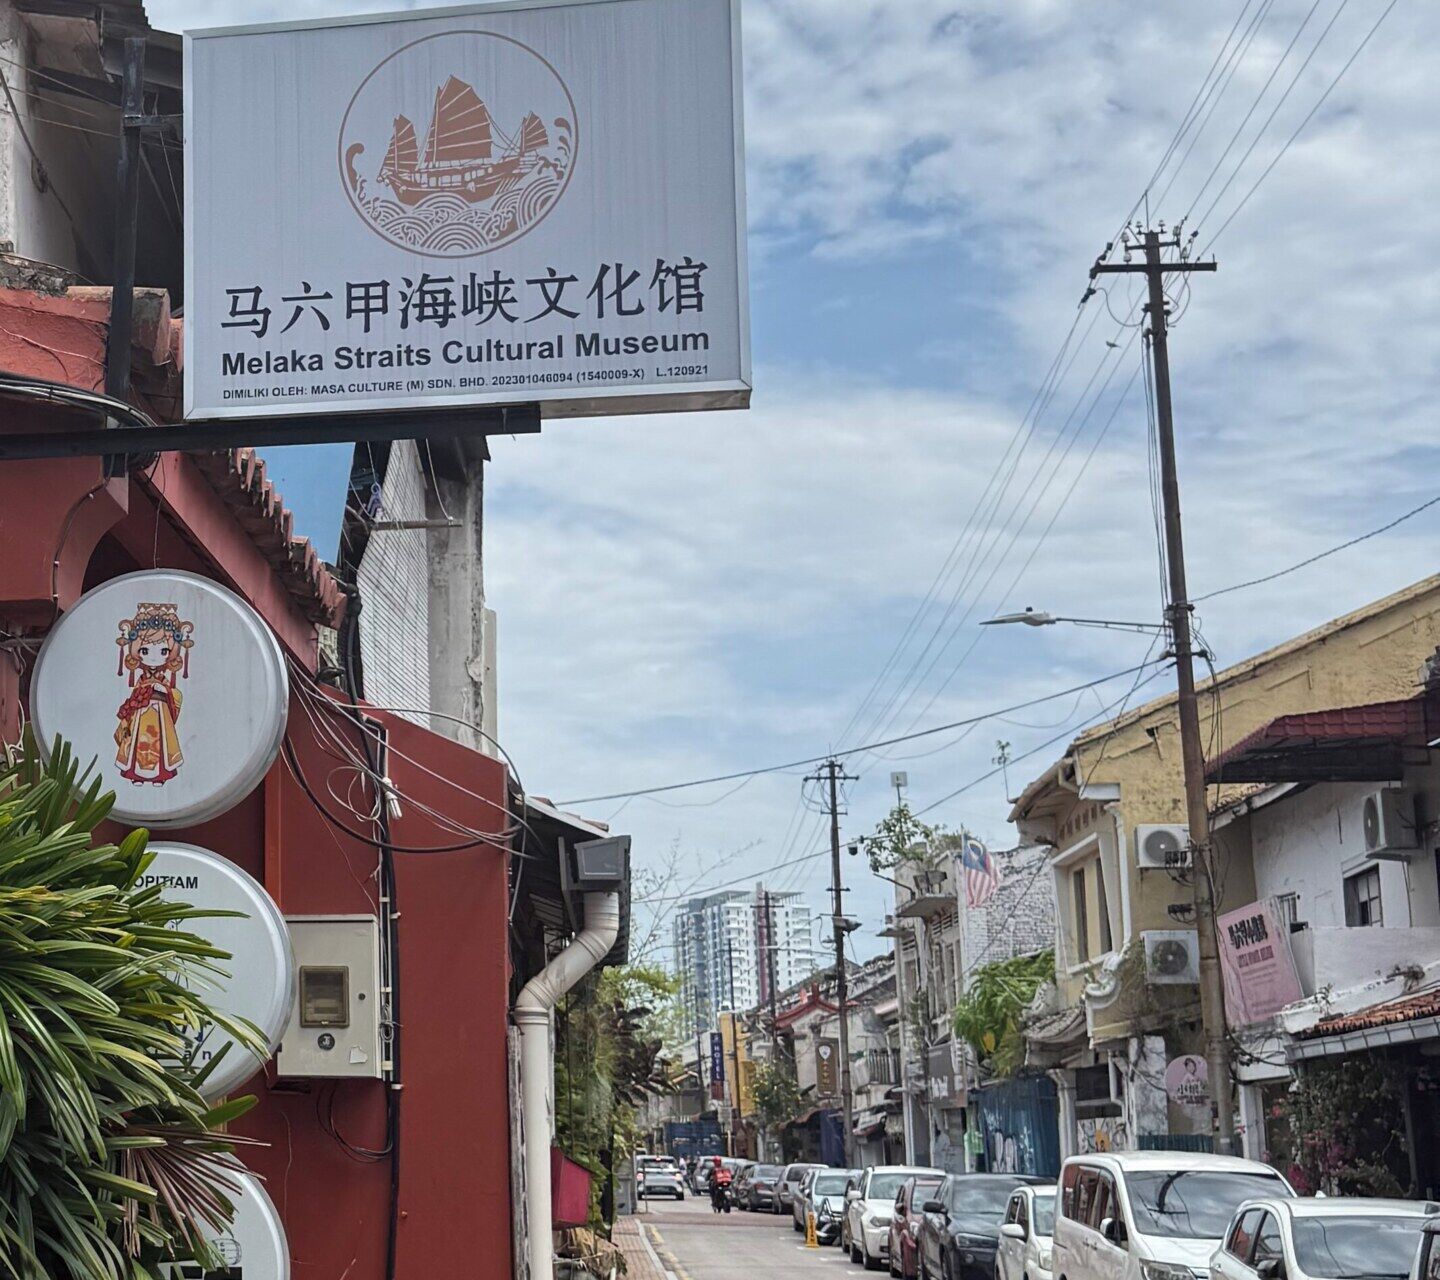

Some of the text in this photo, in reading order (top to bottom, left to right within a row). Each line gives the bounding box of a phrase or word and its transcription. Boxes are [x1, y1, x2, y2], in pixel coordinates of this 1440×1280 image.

[220, 256, 708, 339] 马六甲海峡文化馆
[222, 331, 709, 376] Melaka Straits Cultural Museum
[223, 387, 269, 400] DIMILIKI
[272, 385, 308, 397] OLEH:
[311, 383, 346, 395] MASA
[349, 380, 403, 393] CULTURE
[406, 379, 425, 392] (M)
[427, 378, 456, 390] SDN.
[459, 376, 489, 388] BHD.
[576, 367, 646, 384] (1540009-X)
[656, 364, 709, 378] L.120921
[134, 875, 199, 890] OPITIAM
